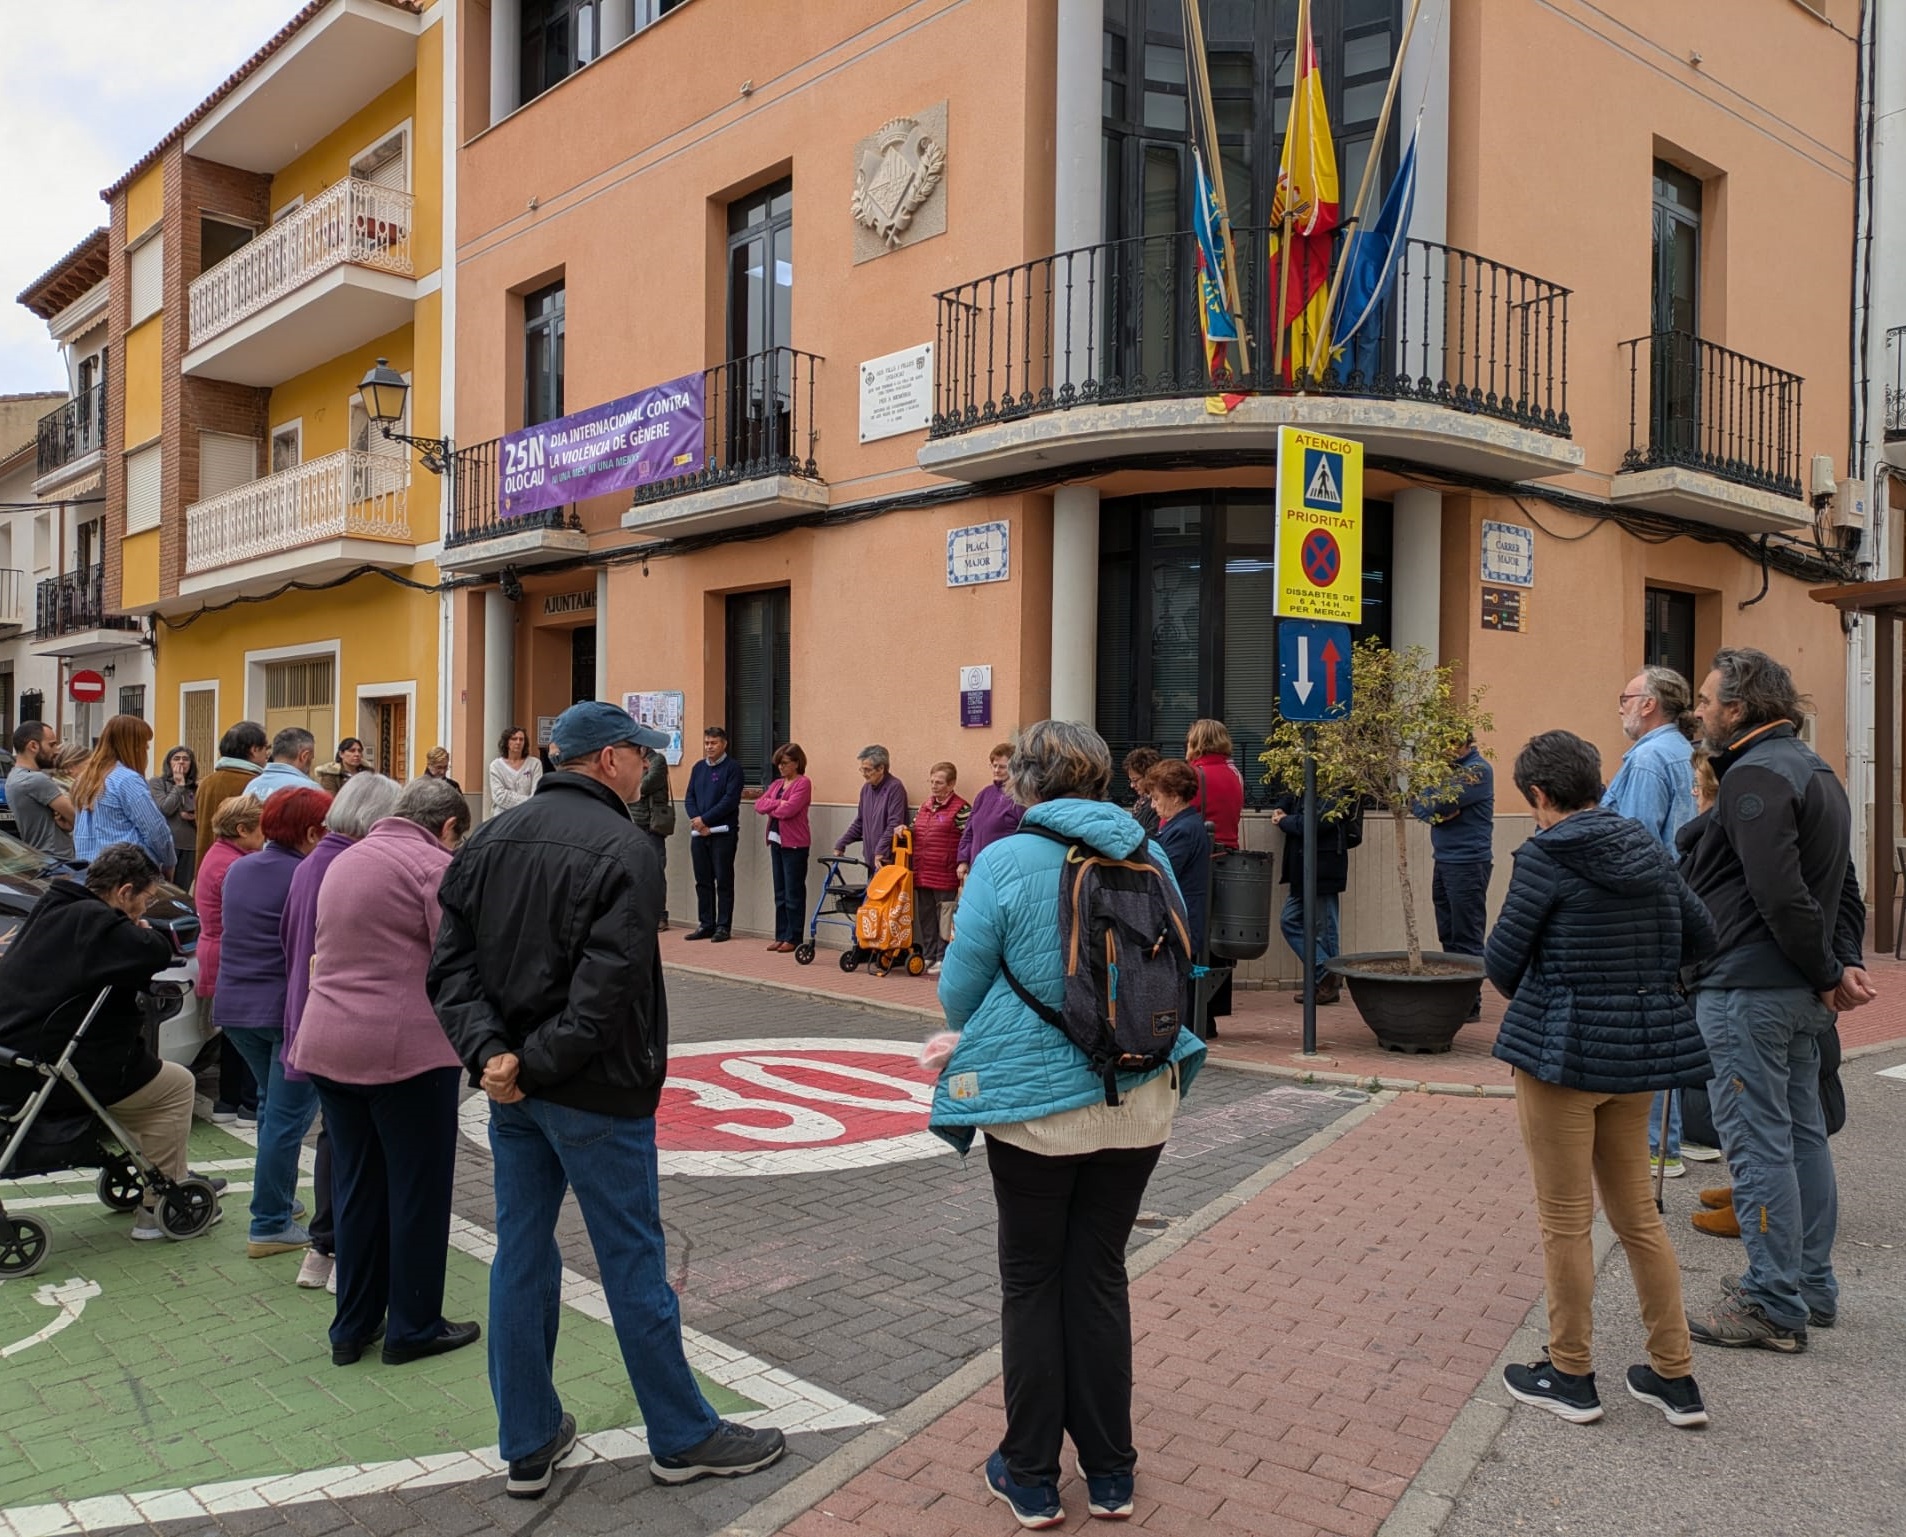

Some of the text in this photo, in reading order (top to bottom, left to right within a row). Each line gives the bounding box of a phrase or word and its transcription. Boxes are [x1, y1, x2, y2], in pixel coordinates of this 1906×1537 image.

[551, 392, 690, 448] DIA INTERNACIONAL CONTRA
[549, 421, 670, 469] LA VIOLÈNCIA DE GÈNERE
[1295, 434, 1352, 454] ATENCIÓ
[505, 434, 545, 475] 25N
[505, 468, 545, 494] OLOCAU
[1287, 510, 1355, 530] PRIORITAT
[966, 542, 989, 553] PLAÇA
[1495, 540, 1520, 553] CARRER
[964, 557, 990, 568] MAJOR
[1286, 588, 1338, 600] DISSABTES
[1290, 605, 1351, 617] PER MERCAT
